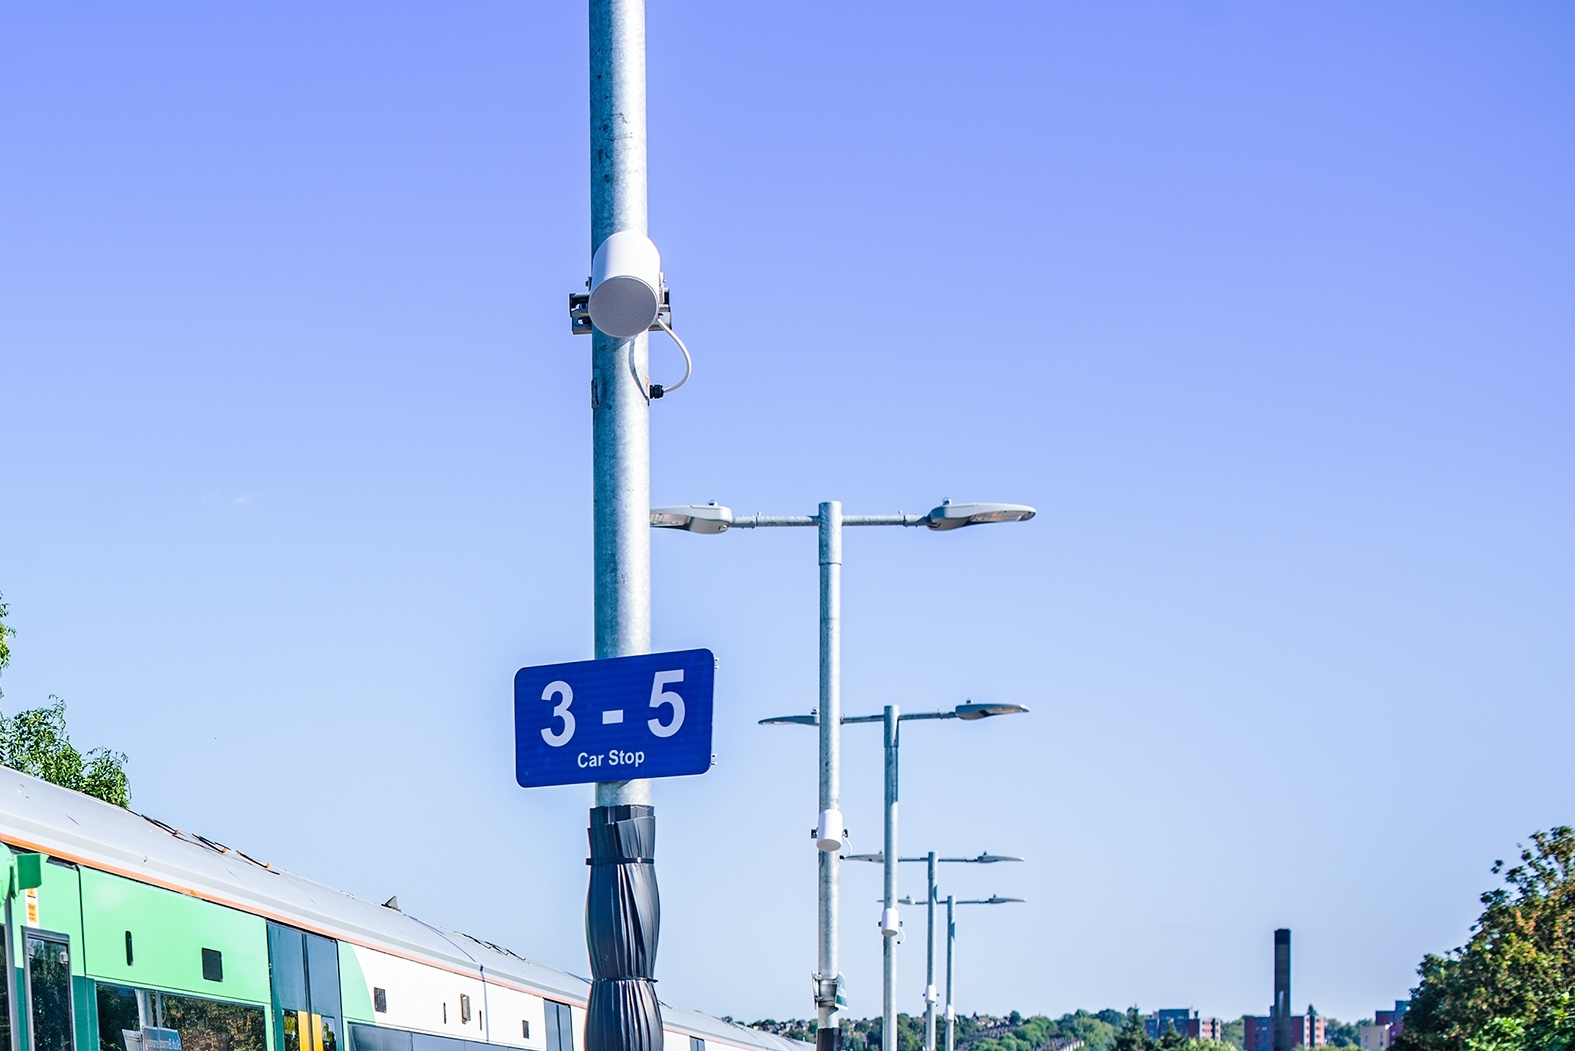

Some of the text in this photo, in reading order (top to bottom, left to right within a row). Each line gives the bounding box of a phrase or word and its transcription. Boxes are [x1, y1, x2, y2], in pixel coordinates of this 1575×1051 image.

[540, 680, 576, 748] 3
[647, 669, 686, 738] 5
[577, 750, 645, 769] Car Stop
